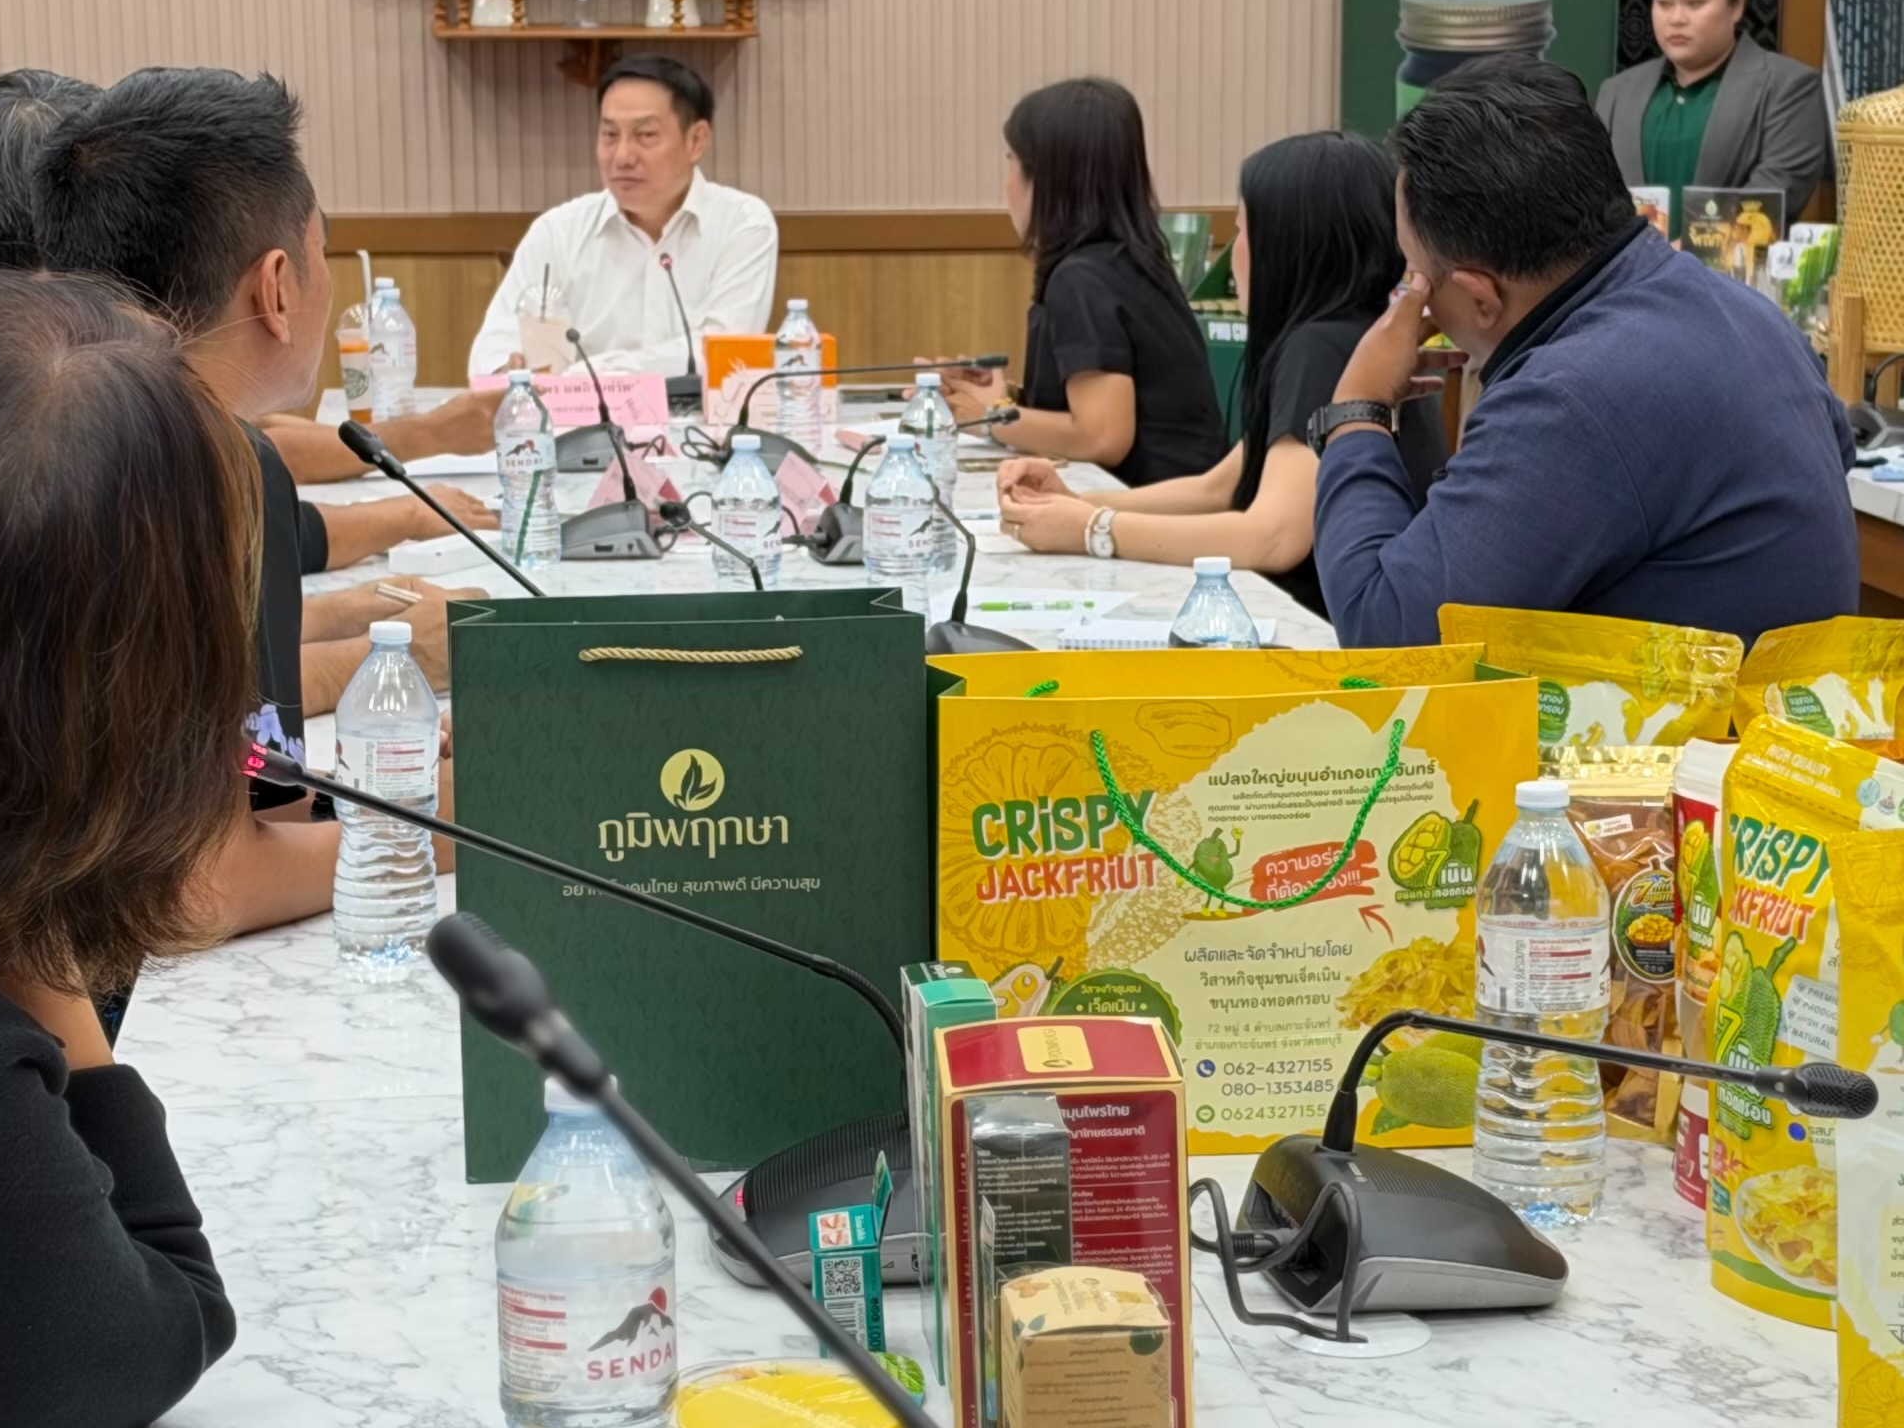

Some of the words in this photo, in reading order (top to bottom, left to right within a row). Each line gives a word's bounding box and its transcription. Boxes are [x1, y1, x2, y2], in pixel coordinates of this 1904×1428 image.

[597, 810, 789, 862] ภูมิพฤกษา
[682, 877, 747, 897] สุขภาพดี
[750, 876, 821, 893] มีความสุข
[1184, 939, 1353, 963] ผลิตและจัดจำหน่ายโดย
[1199, 965, 1341, 990] วิสาหกิจชุมชนเจ็ดเนิน
[1086, 995, 1136, 1016] เจ็ดเนิน
[1209, 992, 1331, 1014] ขนุนทองทอดกรอบ
[1802, 1000, 1838, 1021] PRODUC
[1223, 1058, 1333, 1076] 062-4327155
[1221, 1078, 1335, 1097] 080-1353485
[1220, 1103, 1327, 1121] 0624327155
[1069, 1124, 1147, 1140] ญาไทยธรรมชาติ
[586, 1345, 677, 1381] SENDA
